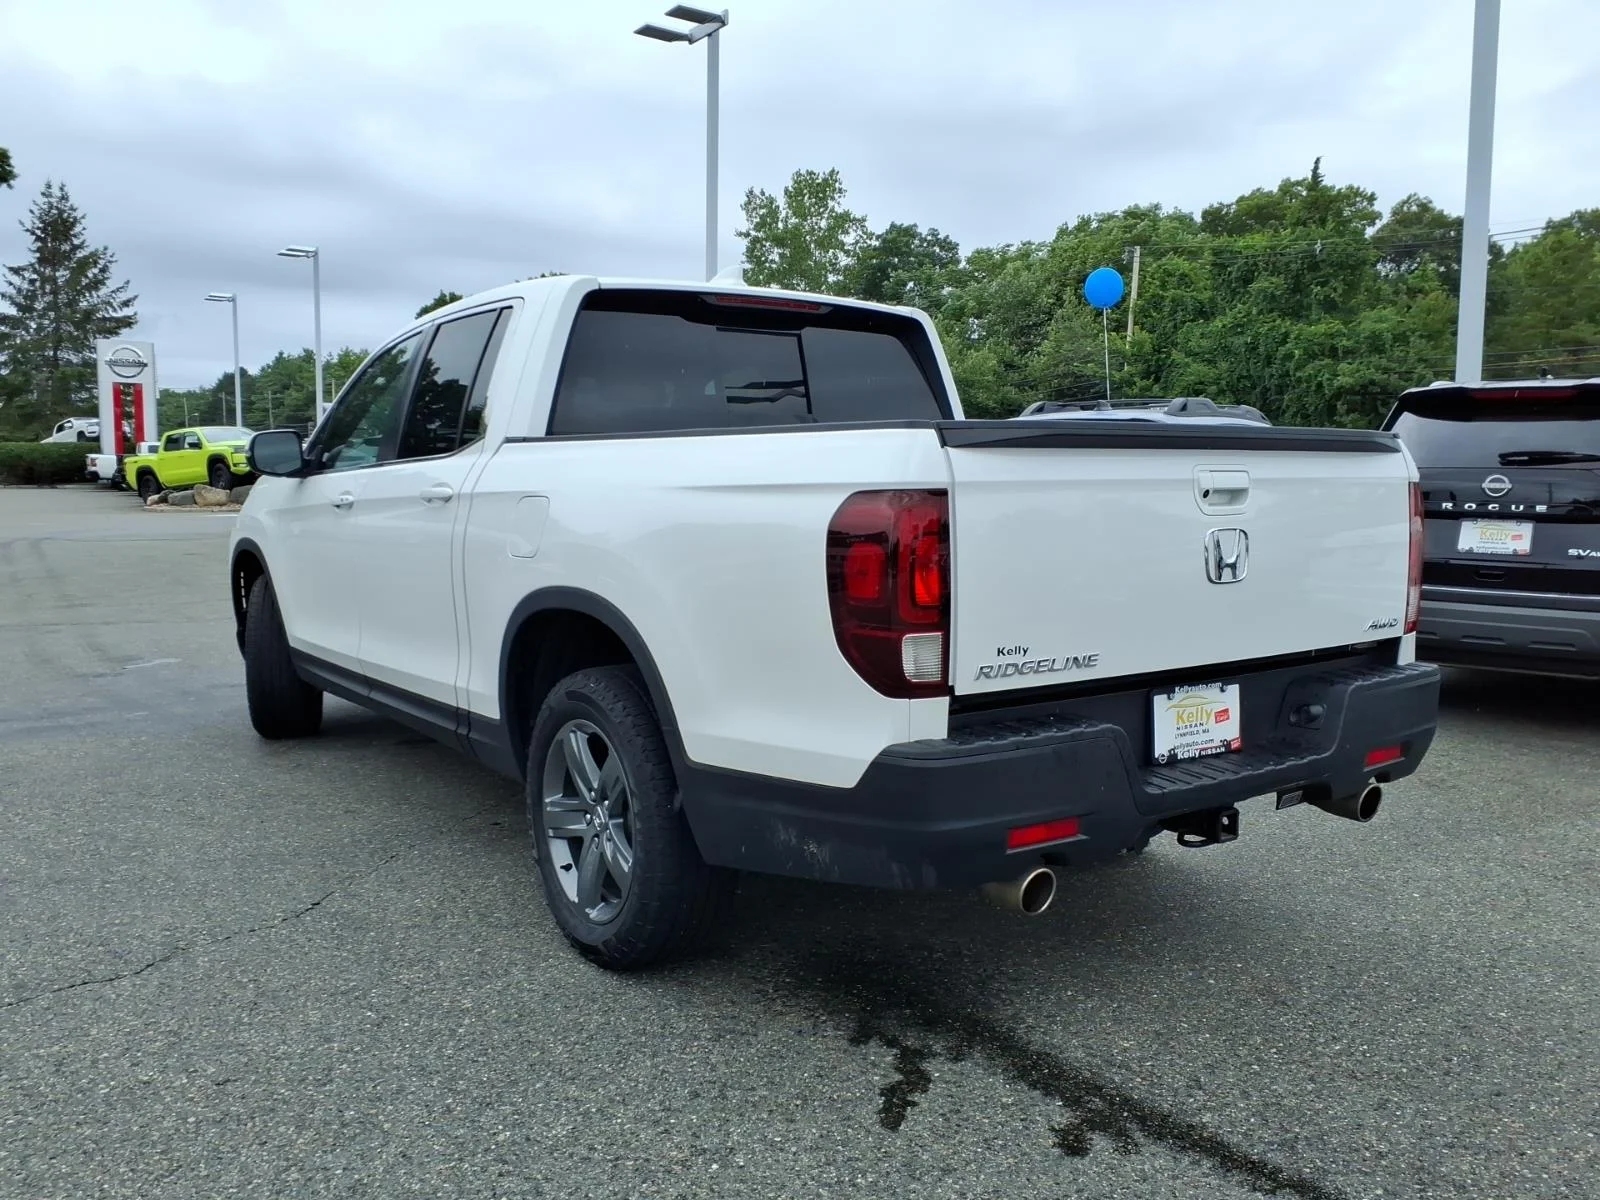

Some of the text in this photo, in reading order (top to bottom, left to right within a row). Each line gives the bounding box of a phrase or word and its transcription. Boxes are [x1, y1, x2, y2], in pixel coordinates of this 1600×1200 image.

[1442, 503, 1548, 512] ROGUE
[1480, 528, 1511, 541] Kelly
[1363, 617, 1398, 632] AWD
[997, 646, 1029, 656] Kelly
[974, 653, 1100, 681] RIDGELINE
[1175, 682, 1222, 694] Kellyauto.com
[1176, 707, 1213, 726] Kelly
[1176, 722, 1204, 731] NISSAN
[1174, 739, 1214, 750] kellyauto.com
[1177, 747, 1225, 760] Kelly NISSAN
